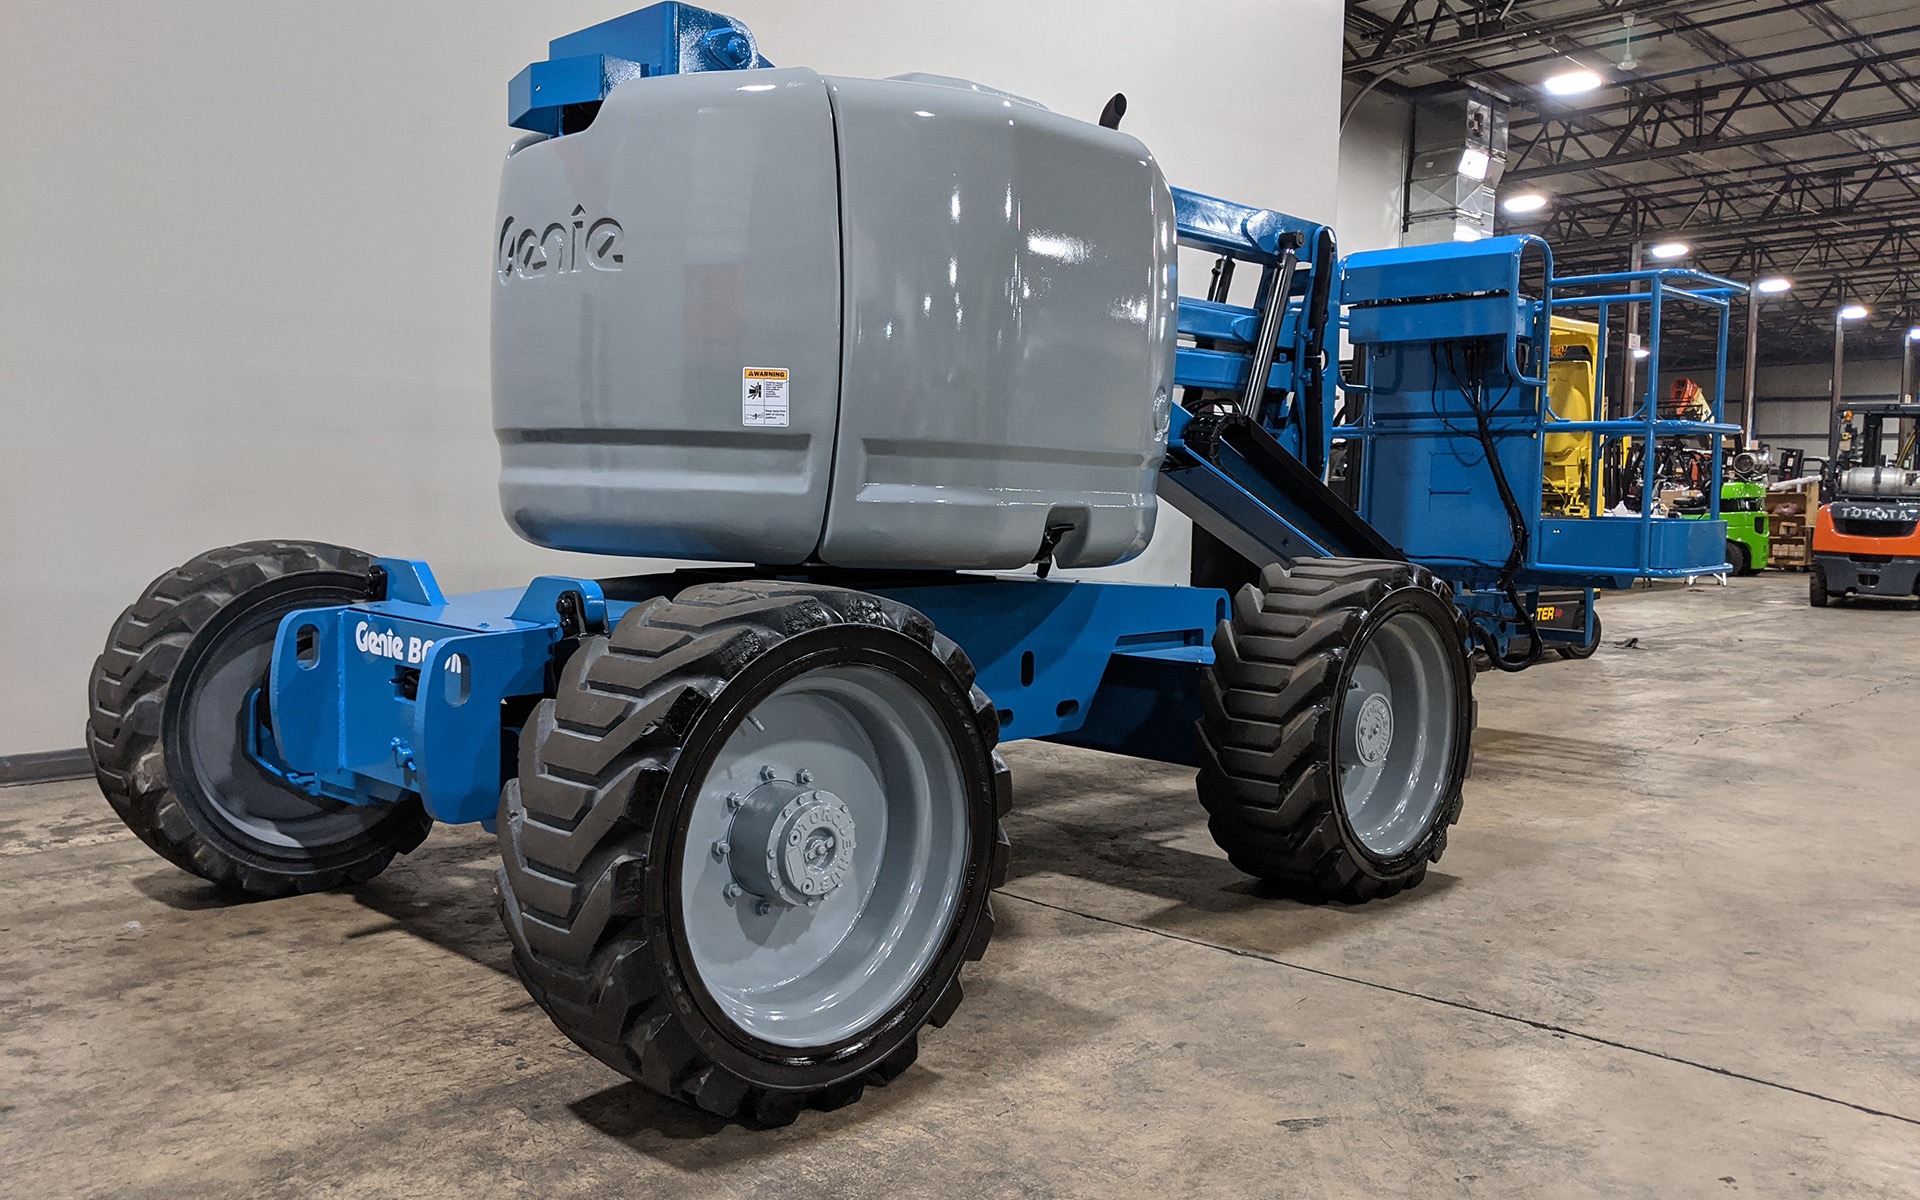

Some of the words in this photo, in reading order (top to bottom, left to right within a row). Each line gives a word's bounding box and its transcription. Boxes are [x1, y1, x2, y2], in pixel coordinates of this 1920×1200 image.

[1842, 507, 1908, 520] TOYOTA
[1536, 607, 1555, 621] TER
[355, 621, 404, 660] Genie
